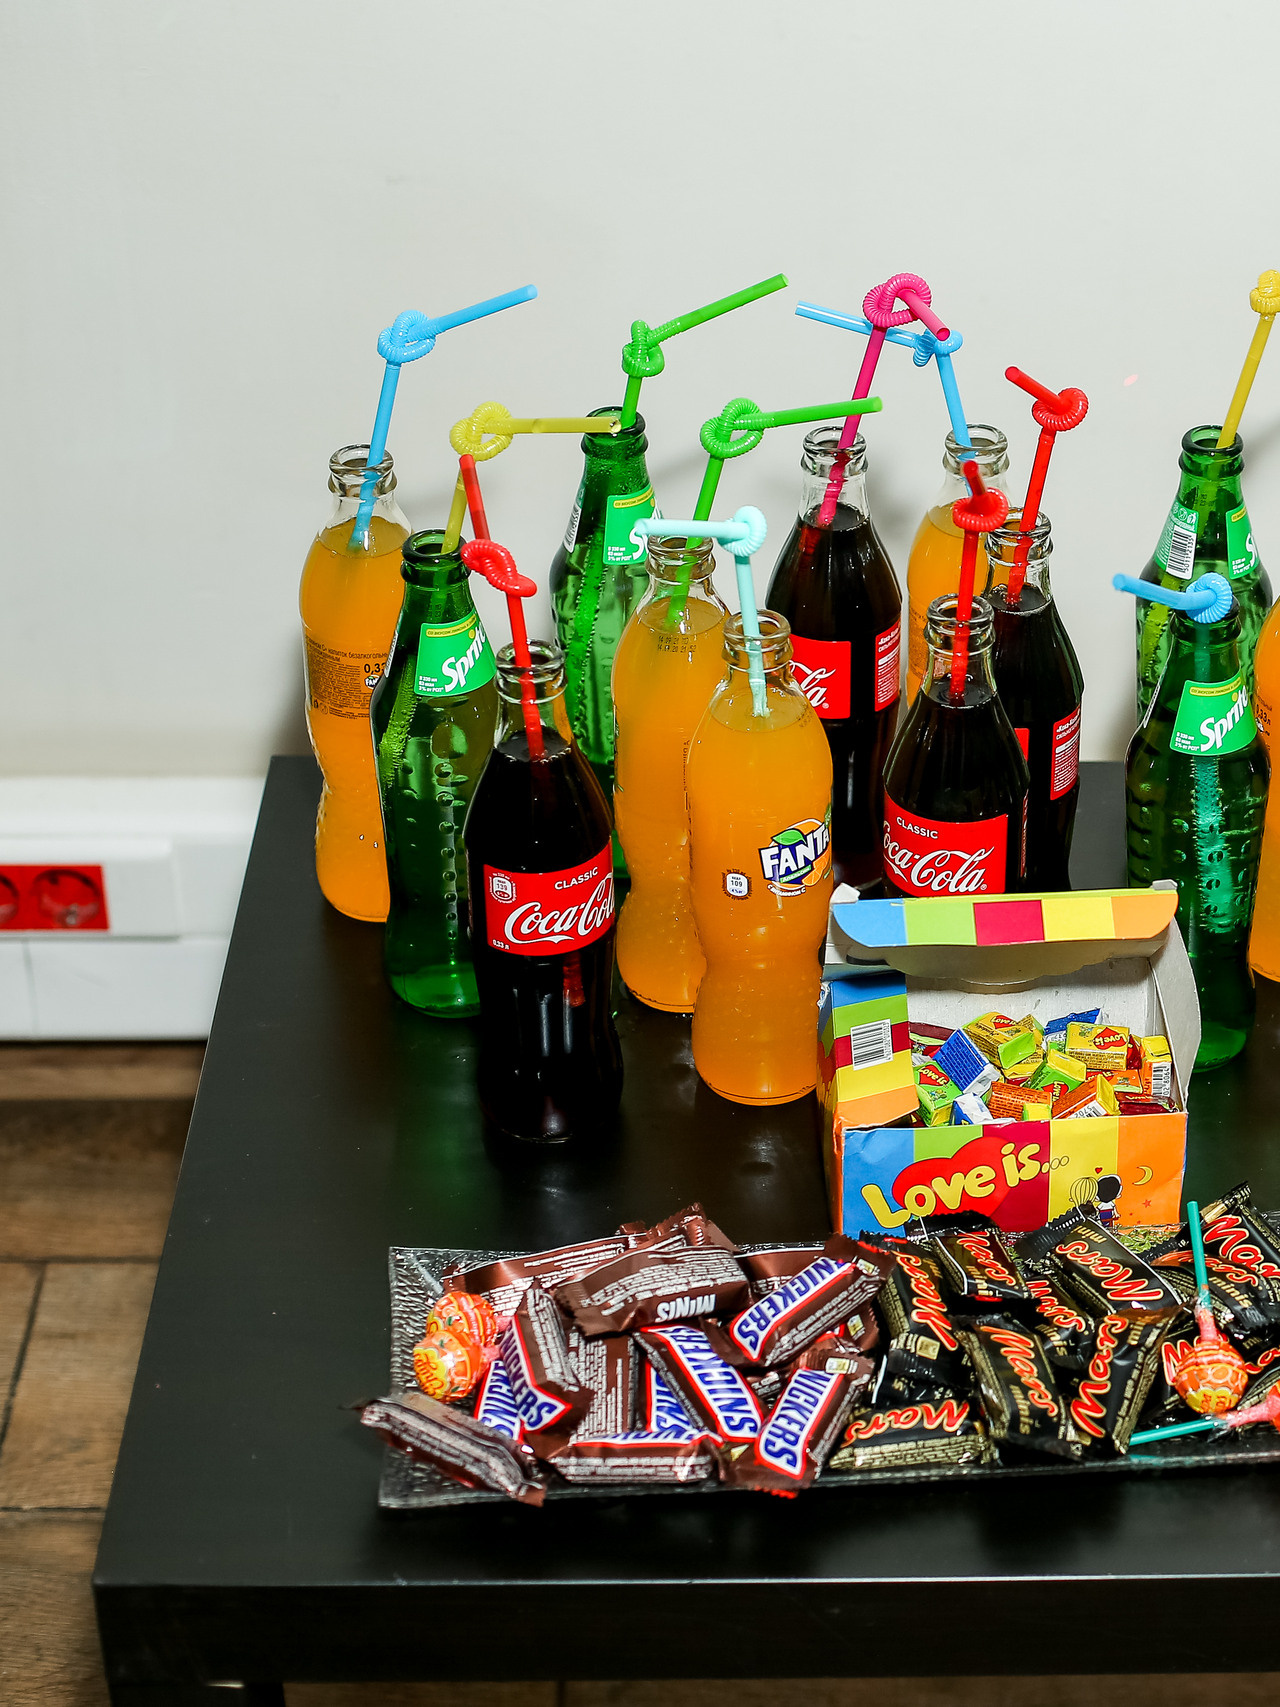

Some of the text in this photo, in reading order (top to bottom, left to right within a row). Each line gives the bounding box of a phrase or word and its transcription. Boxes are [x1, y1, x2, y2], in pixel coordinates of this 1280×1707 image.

[1199, 684, 1250, 753] Sprite
[759, 822, 830, 880] FANTA
[896, 816, 938, 840] CLASSIC
[554, 866, 599, 891] CLASSIC
[730, 880, 743, 888] 109
[504, 871, 616, 945] Coca-Col
[918, 1066, 938, 1081] Love
[861, 1165, 996, 1229] Love
[956, 1230, 1016, 1286] Mars
[1073, 1224, 1107, 1244] mini
[1055, 1241, 1164, 1300] Mars
[1208, 1275, 1253, 1308] minis
[655, 1294, 717, 1323] MINIS
[737, 1257, 840, 1352] NICKERS
[892, 1250, 959, 1351] Mars
[1026, 1279, 1086, 1333] Mars
[980, 1325, 1058, 1417] Mars
[1071, 1314, 1129, 1438] Mars
[764, 1369, 834, 1468] NICKERS
[840, 1399, 970, 1448] Mars
[1009, 1384, 1031, 1435] minis
